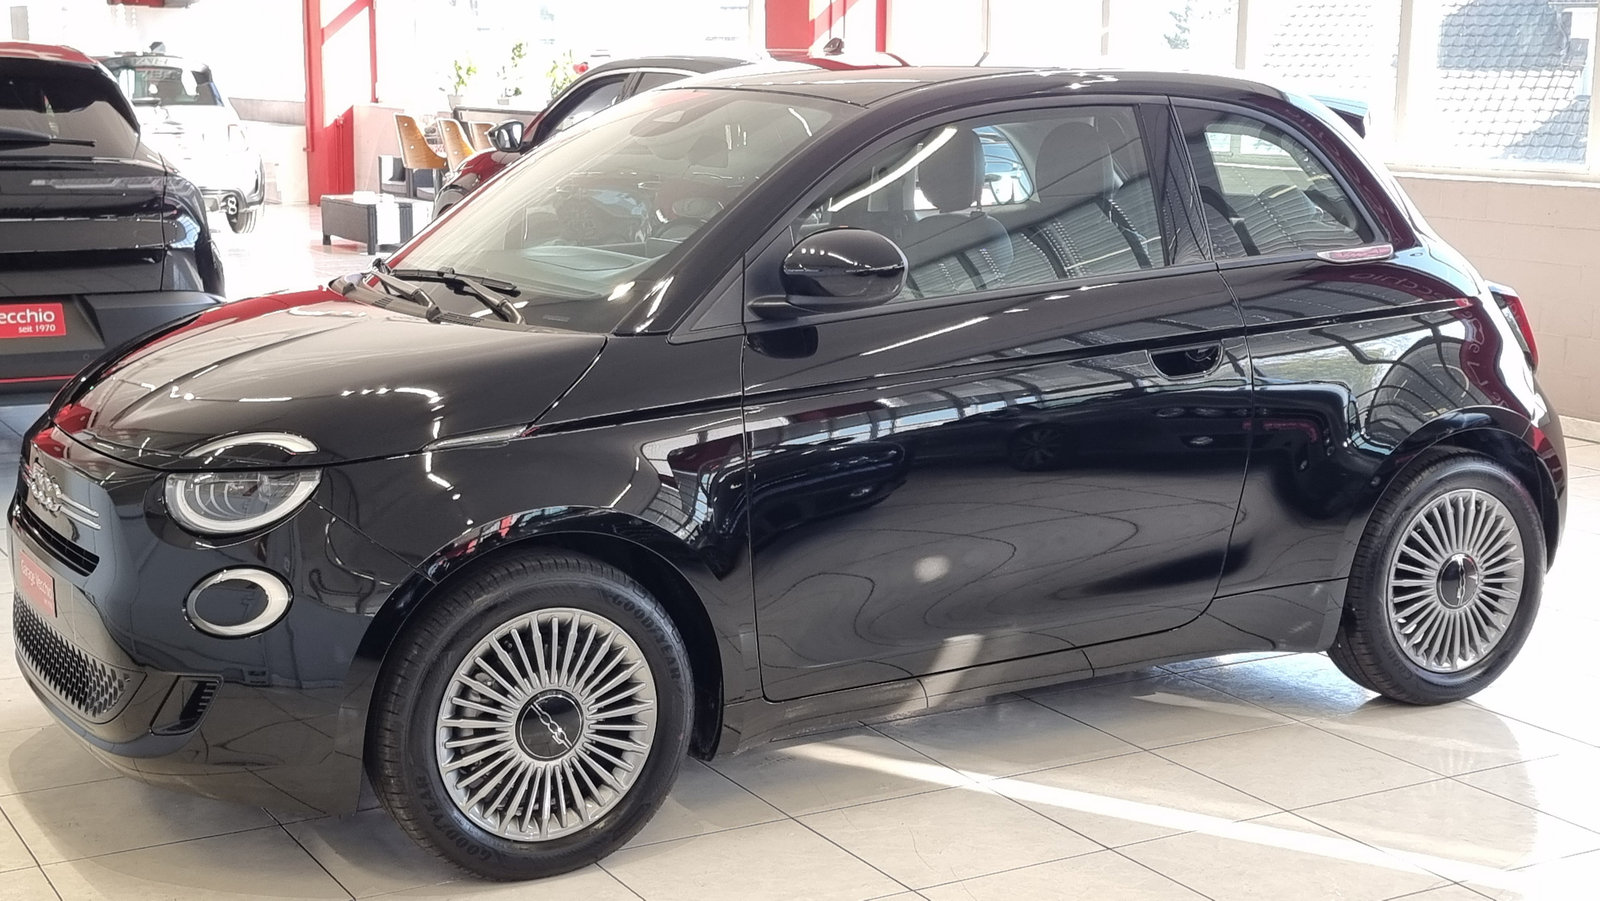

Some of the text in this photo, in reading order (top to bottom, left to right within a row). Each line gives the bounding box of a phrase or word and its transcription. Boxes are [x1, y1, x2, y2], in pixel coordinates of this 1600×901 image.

[0, 308, 55, 325] ecchio
[18, 324, 56, 333] seit 1970
[613, 594, 681, 680] GOODYEAR
[415, 775, 492, 861] GOODYEAR
